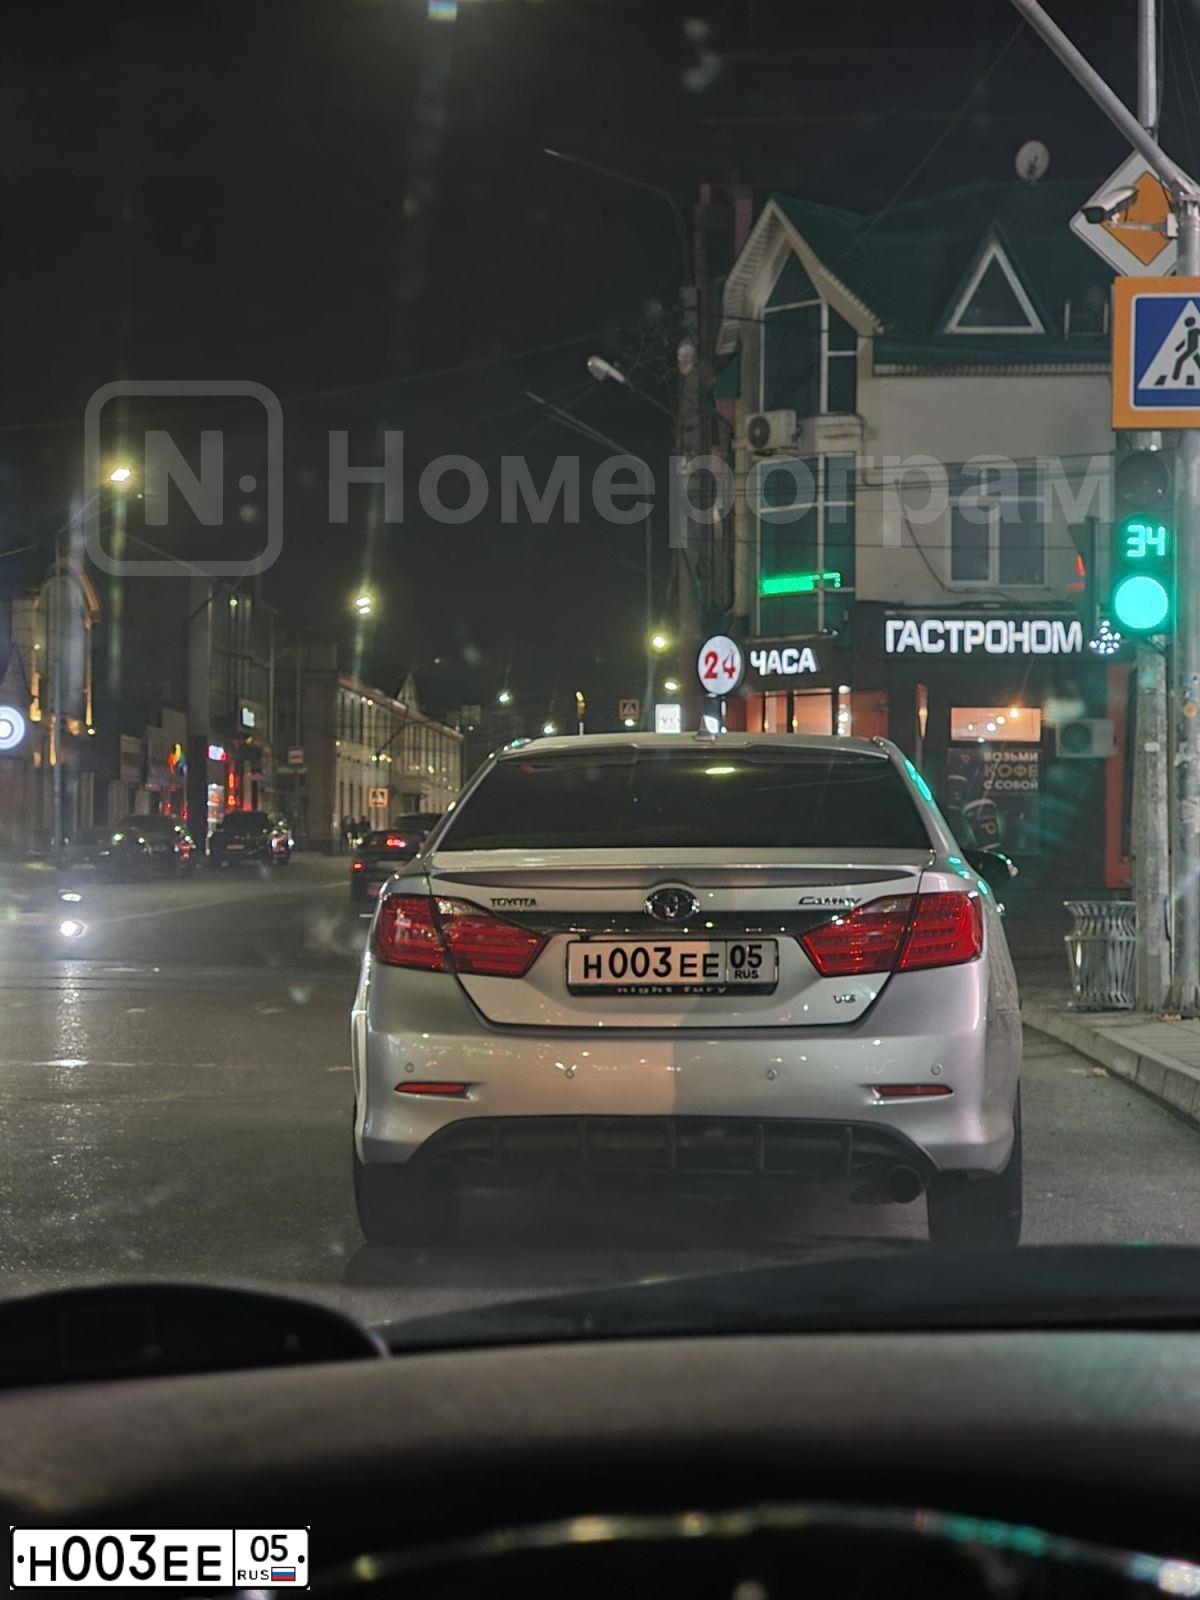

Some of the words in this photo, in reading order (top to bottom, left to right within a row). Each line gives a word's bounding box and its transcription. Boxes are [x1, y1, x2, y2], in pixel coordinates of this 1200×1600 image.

[1126, 524, 1165, 557] 34
[885, 619, 1083, 654] ГАСТРОНОМ
[703, 651, 736, 679] 24
[750, 647, 817, 676] ЧАСА
[984, 764, 1038, 778] КОФЕ
[490, 897, 537, 907] TOYOTA
[730, 945, 762, 968] 05
[735, 969, 759, 979] RUS
